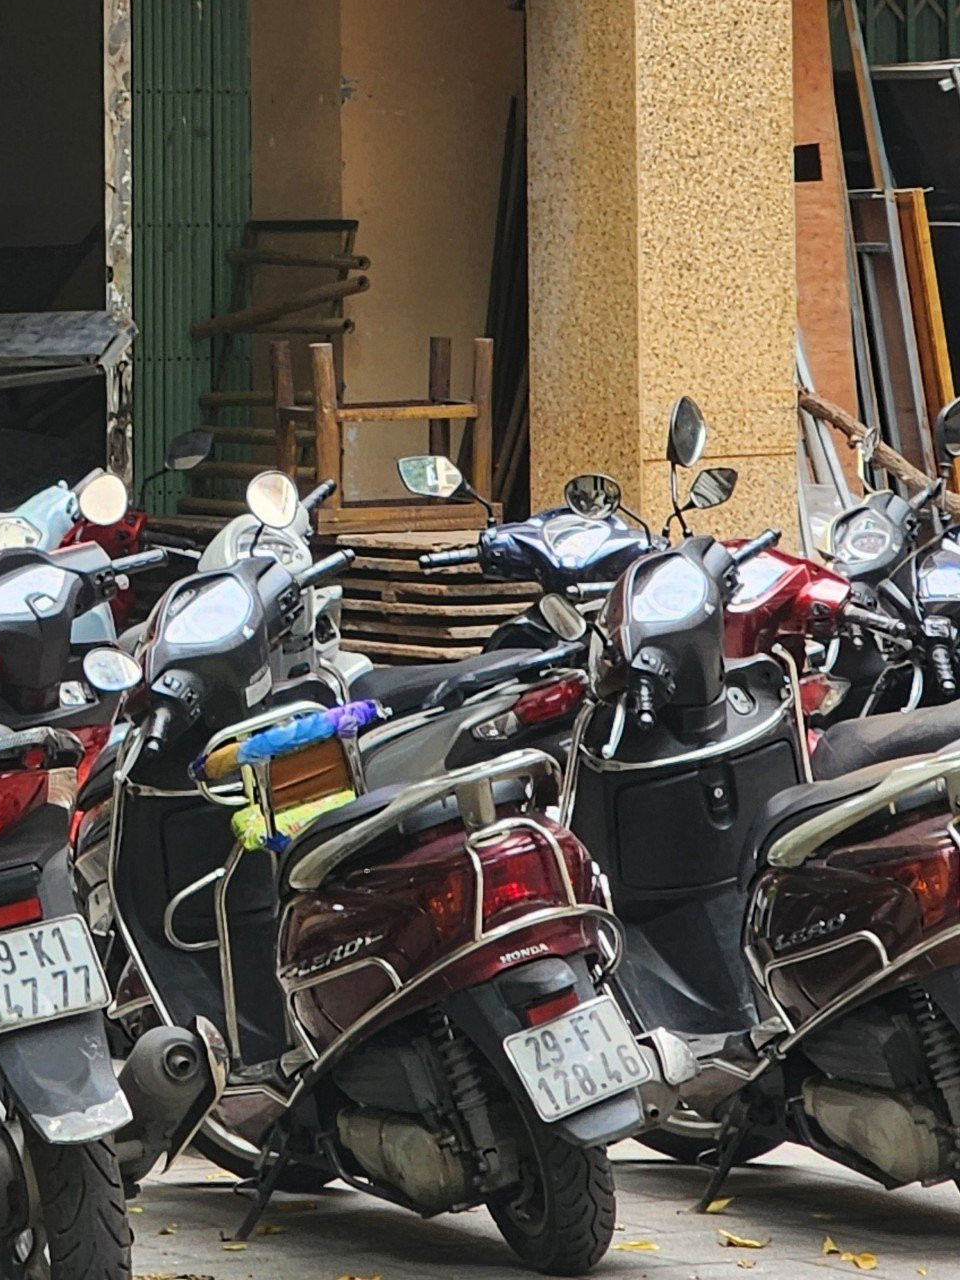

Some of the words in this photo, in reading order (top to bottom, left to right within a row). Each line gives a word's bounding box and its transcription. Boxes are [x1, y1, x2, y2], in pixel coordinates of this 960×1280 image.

[500, 943, 549, 963] HONDA
[524, 1010, 611, 1071] 29-F1
[538, 1044, 640, 1111] 128.46
